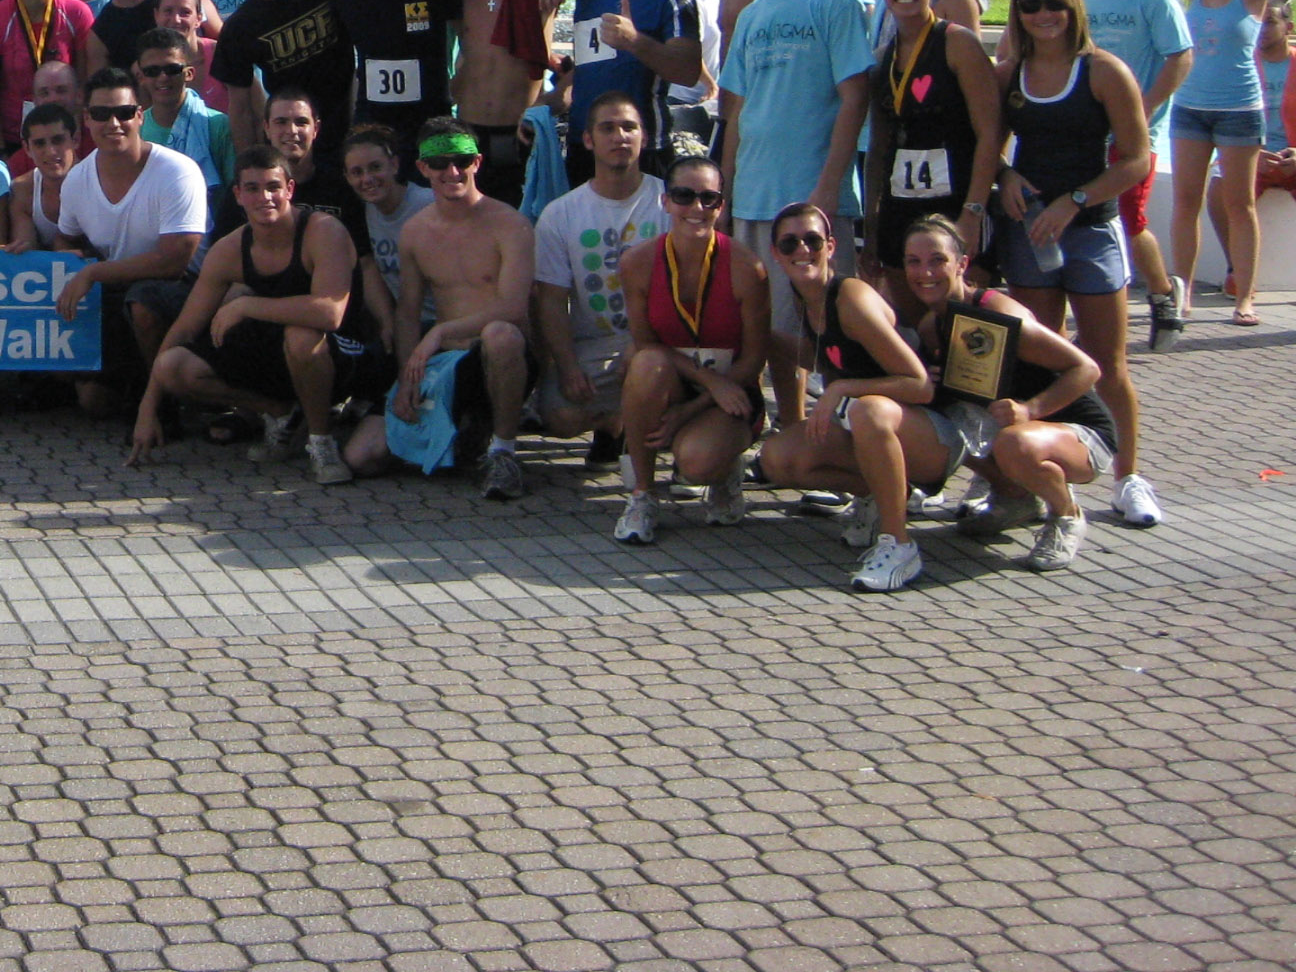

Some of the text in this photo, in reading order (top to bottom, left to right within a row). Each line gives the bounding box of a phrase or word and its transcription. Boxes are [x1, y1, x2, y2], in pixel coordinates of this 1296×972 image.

[271, 9, 332, 59] UCF
[589, 27, 600, 54] 4
[378, 69, 406, 95] 30
[904, 160, 932, 190] 14
